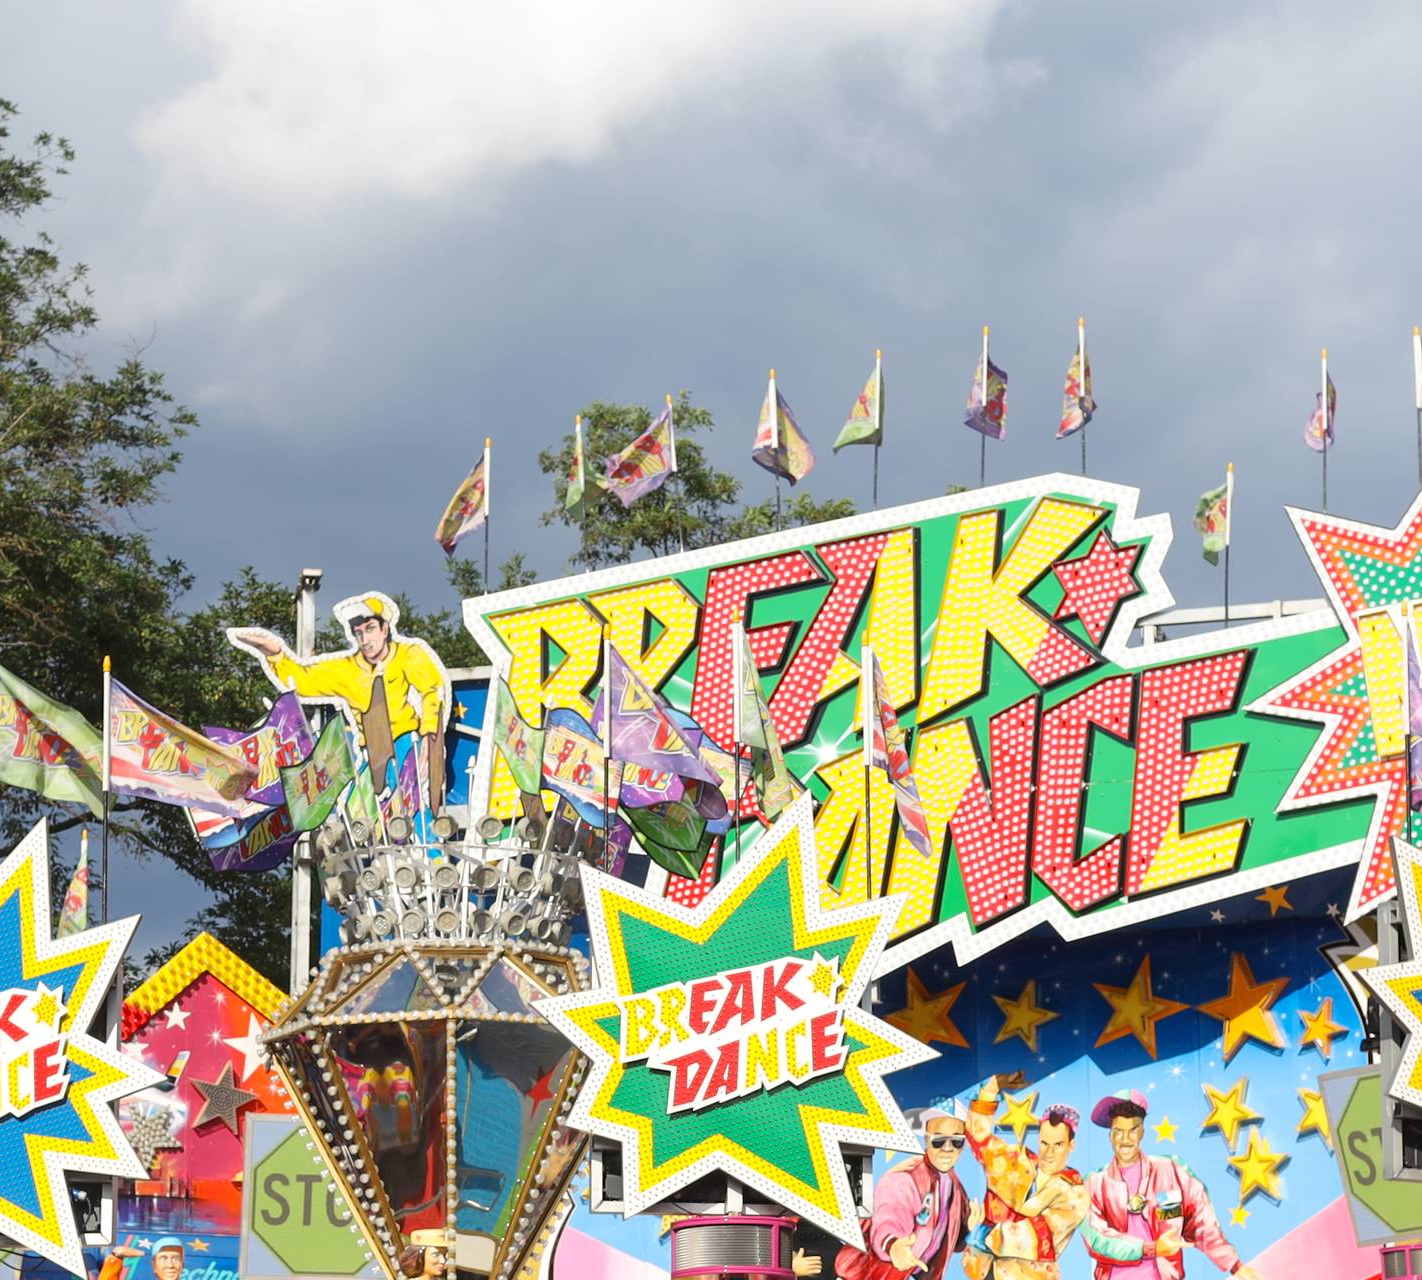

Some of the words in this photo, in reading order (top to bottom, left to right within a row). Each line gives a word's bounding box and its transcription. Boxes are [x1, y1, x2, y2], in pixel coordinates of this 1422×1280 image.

[665, 648, 1255, 941] ANCE
[623, 962, 806, 1059] BREAK
[673, 1010, 845, 1109] DANCE
[260, 1173, 353, 1228] STO
